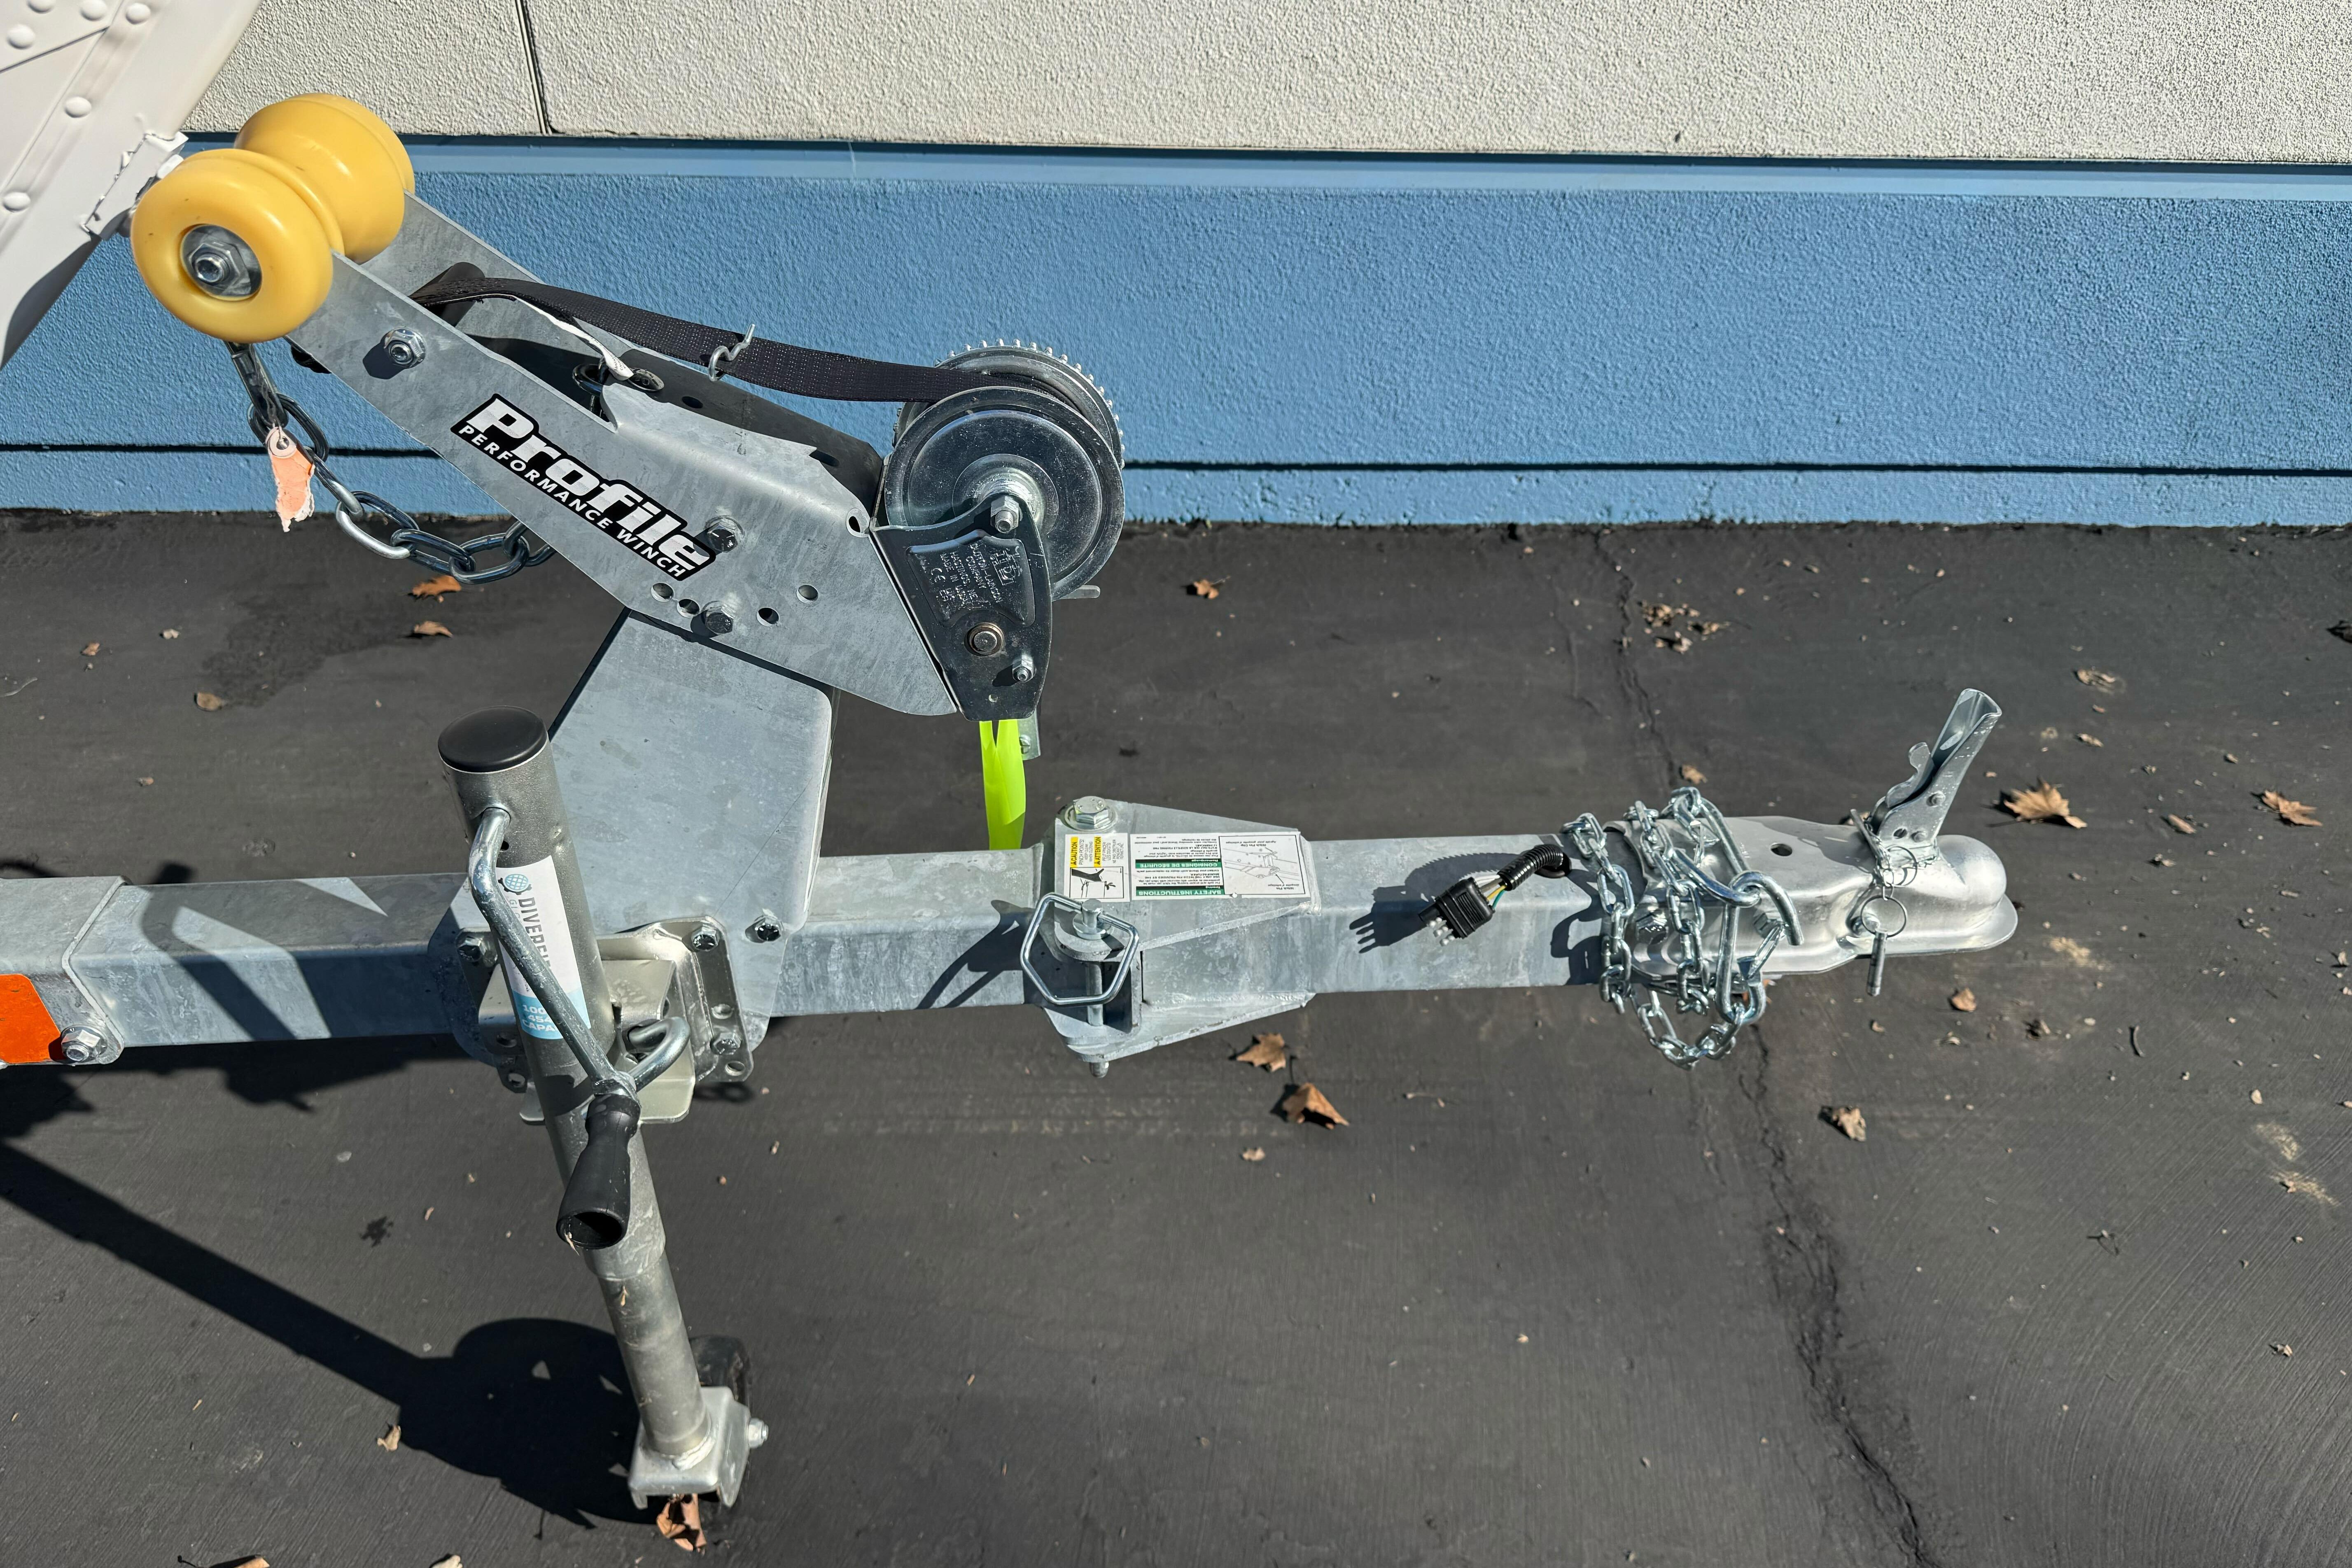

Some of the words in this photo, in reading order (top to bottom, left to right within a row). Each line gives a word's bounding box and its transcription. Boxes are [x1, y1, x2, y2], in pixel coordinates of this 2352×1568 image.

[458, 425, 613, 529] PERFORMANCE
[616, 528, 686, 577] WINCH
[466, 398, 709, 571] Profile
[940, 553, 955, 572] MADE
[966, 555, 987, 588] COMPANY
[522, 1019, 556, 1031] CAPA
